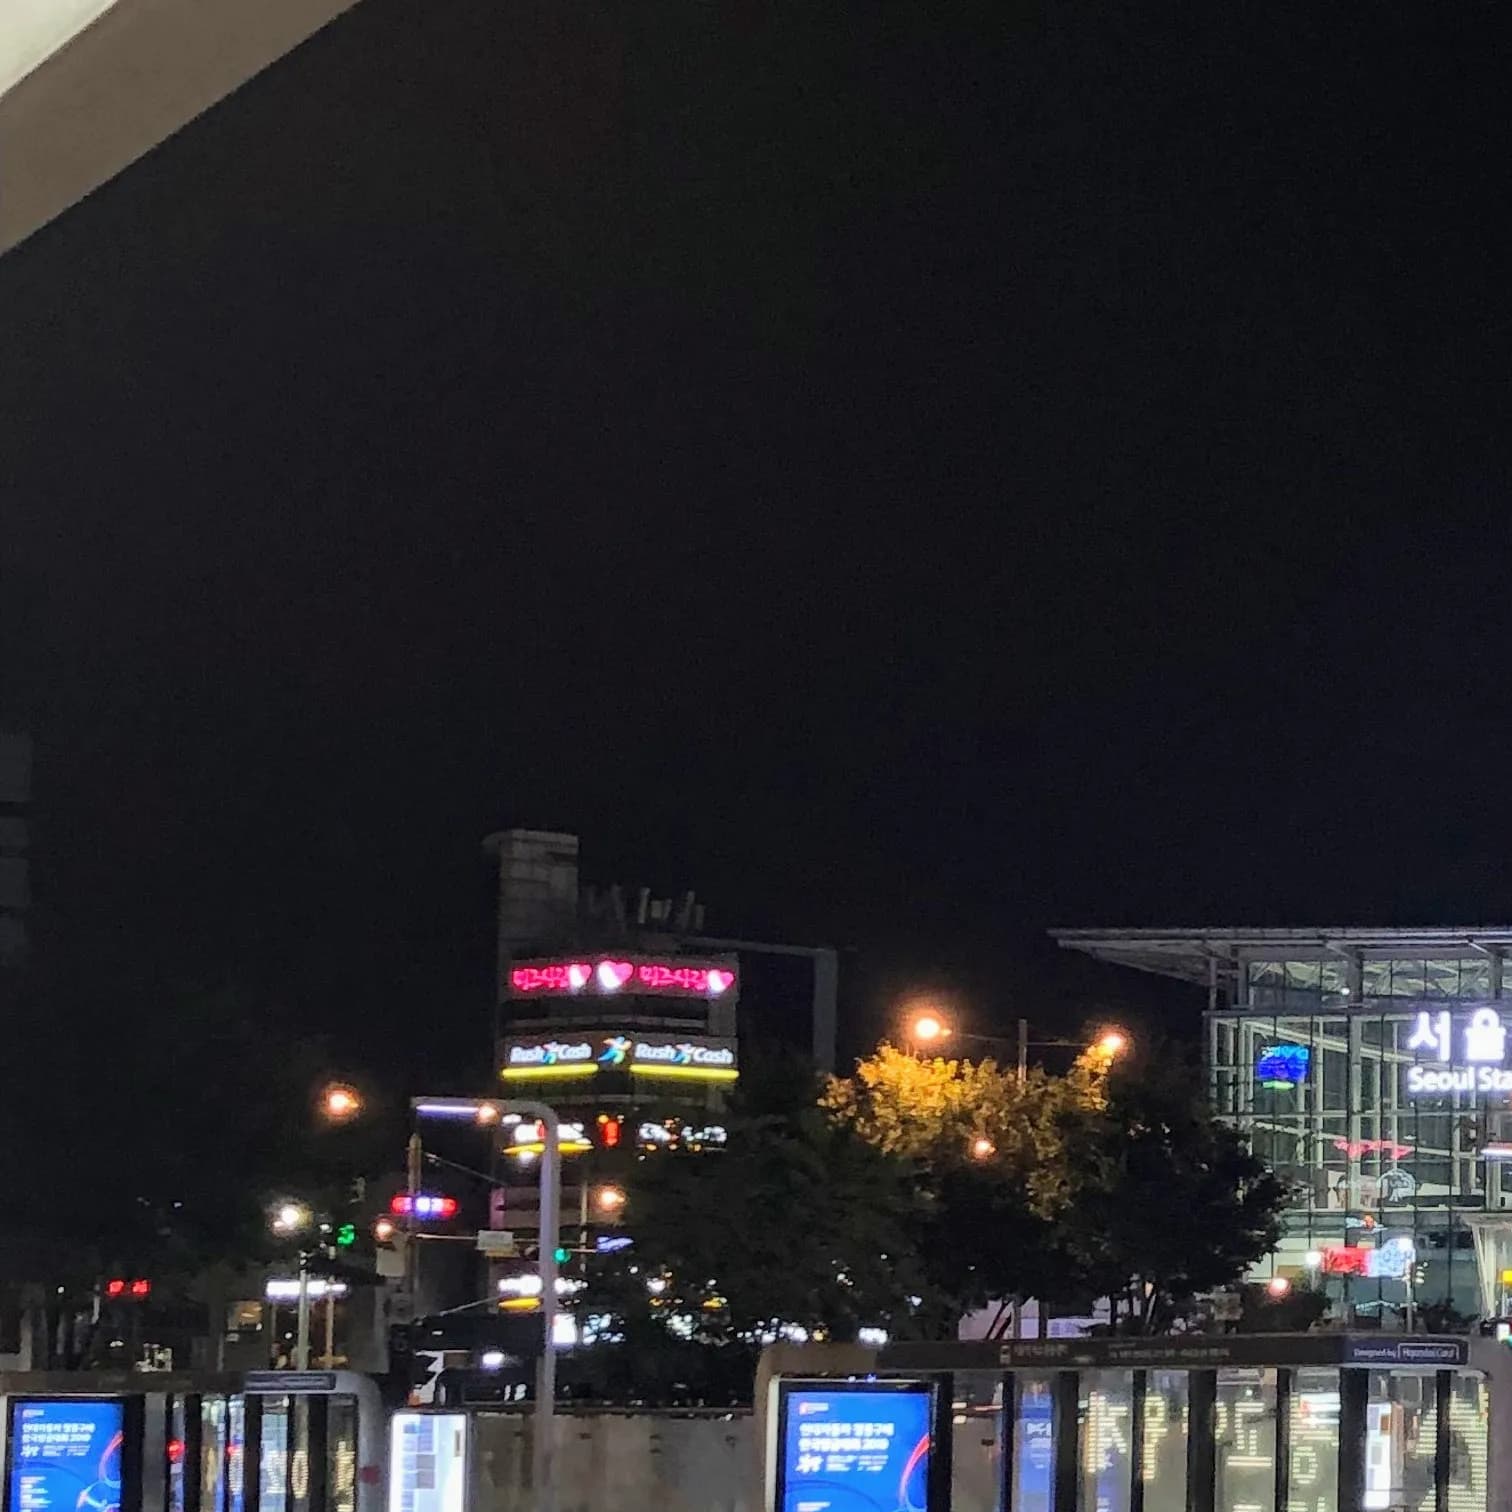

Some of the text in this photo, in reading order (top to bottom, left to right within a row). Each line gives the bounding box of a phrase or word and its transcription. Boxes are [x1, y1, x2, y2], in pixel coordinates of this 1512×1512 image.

[510, 1043, 592, 1063] Rush Cash
[635, 1043, 734, 1065] Rush Cash
[1407, 1065, 1476, 1093] Seoul
